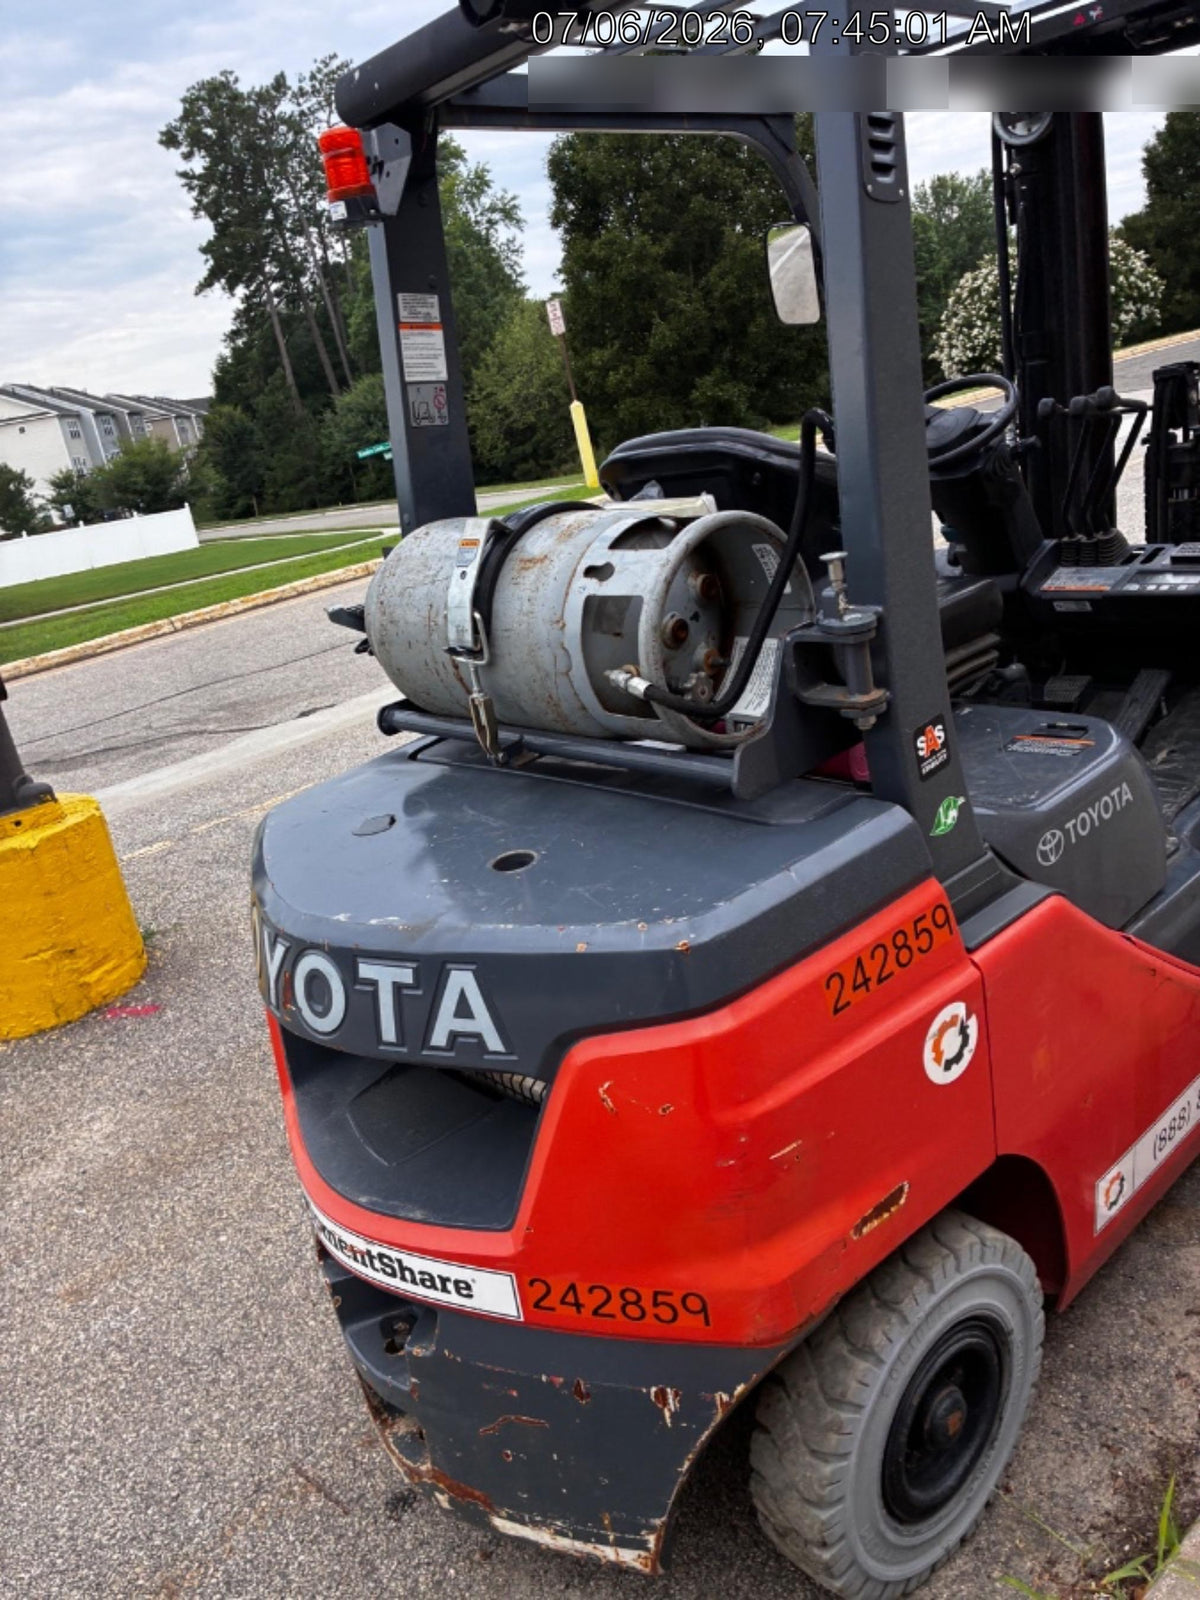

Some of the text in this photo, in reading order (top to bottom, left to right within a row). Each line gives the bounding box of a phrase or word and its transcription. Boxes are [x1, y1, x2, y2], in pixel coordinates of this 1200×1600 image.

[916, 724, 945, 758] SAS
[1064, 781, 1134, 844] TOYOTA
[825, 903, 954, 1016] 242859
[1153, 1100, 1191, 1161] (888)
[528, 1277, 711, 1327] 242859
